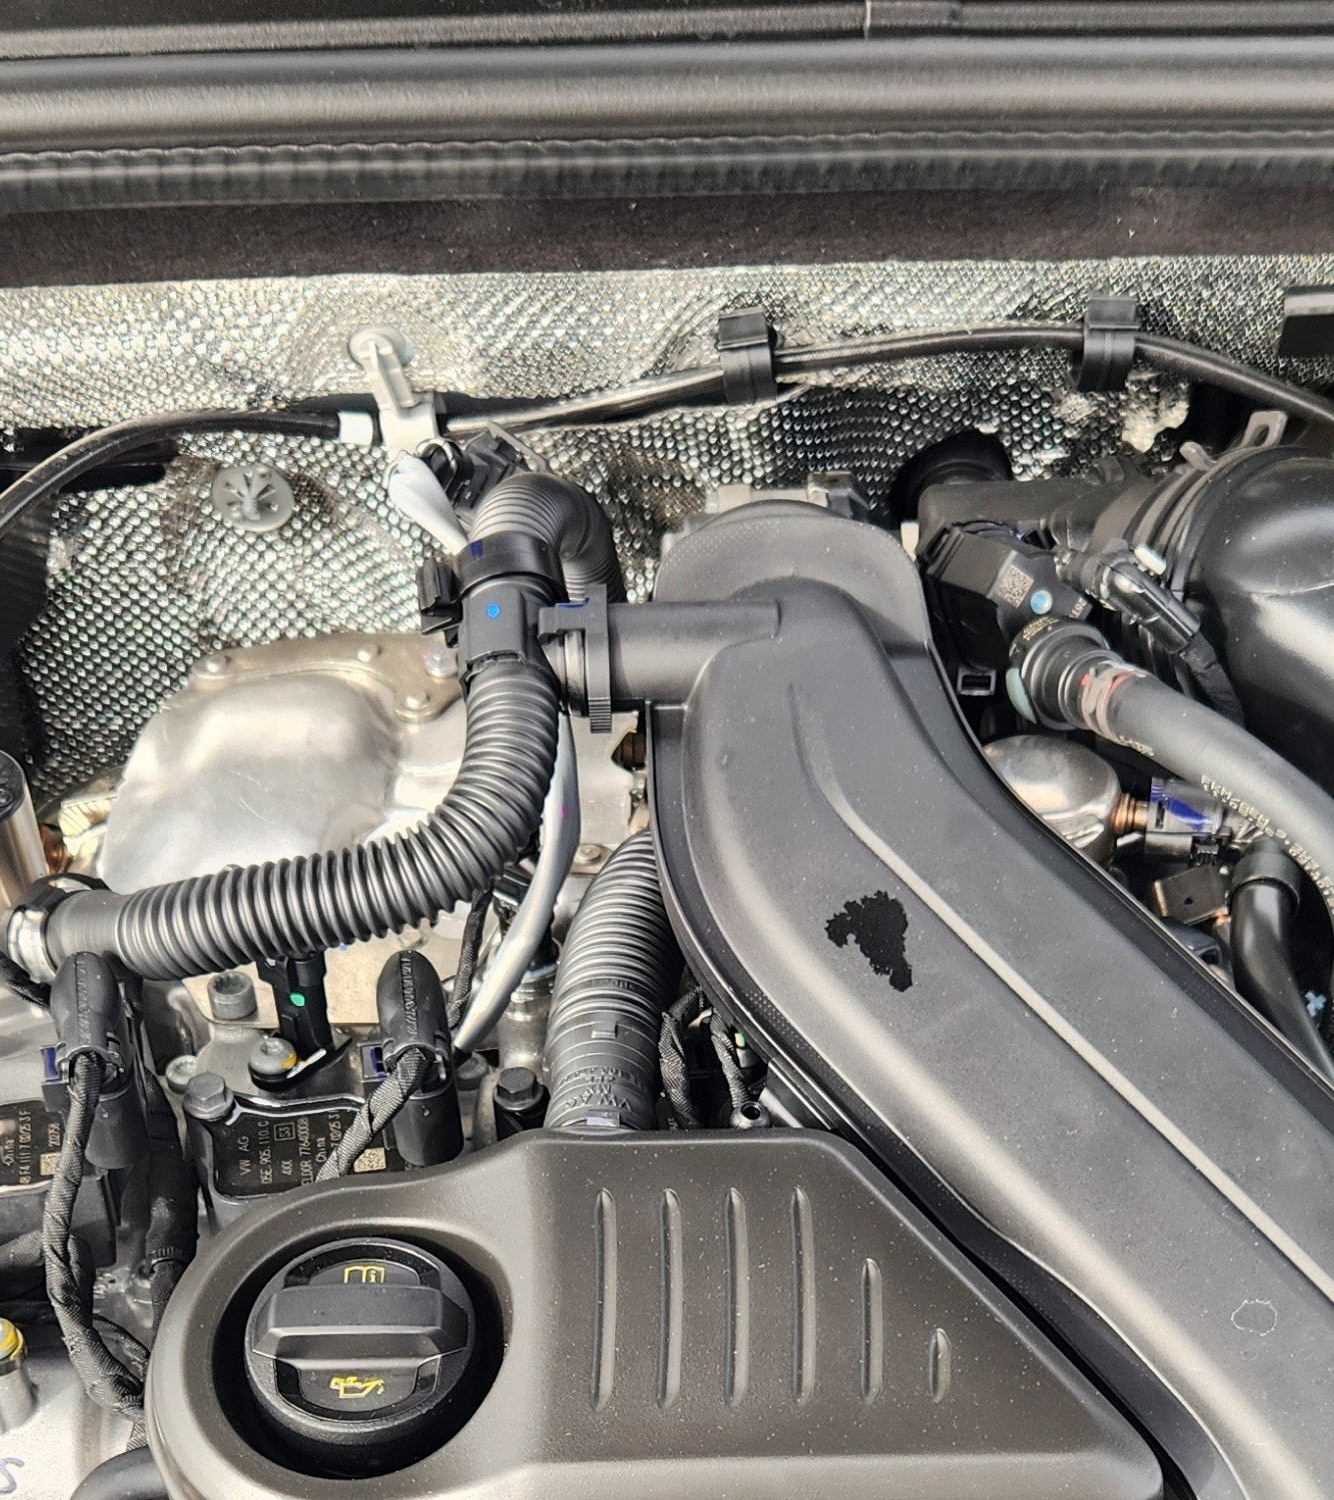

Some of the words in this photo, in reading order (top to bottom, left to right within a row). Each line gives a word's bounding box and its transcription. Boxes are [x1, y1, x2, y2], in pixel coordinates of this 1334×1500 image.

[238, 1136, 250, 1152] AG
[315, 1137, 327, 1163] China
[239, 1159, 252, 1176] VW
